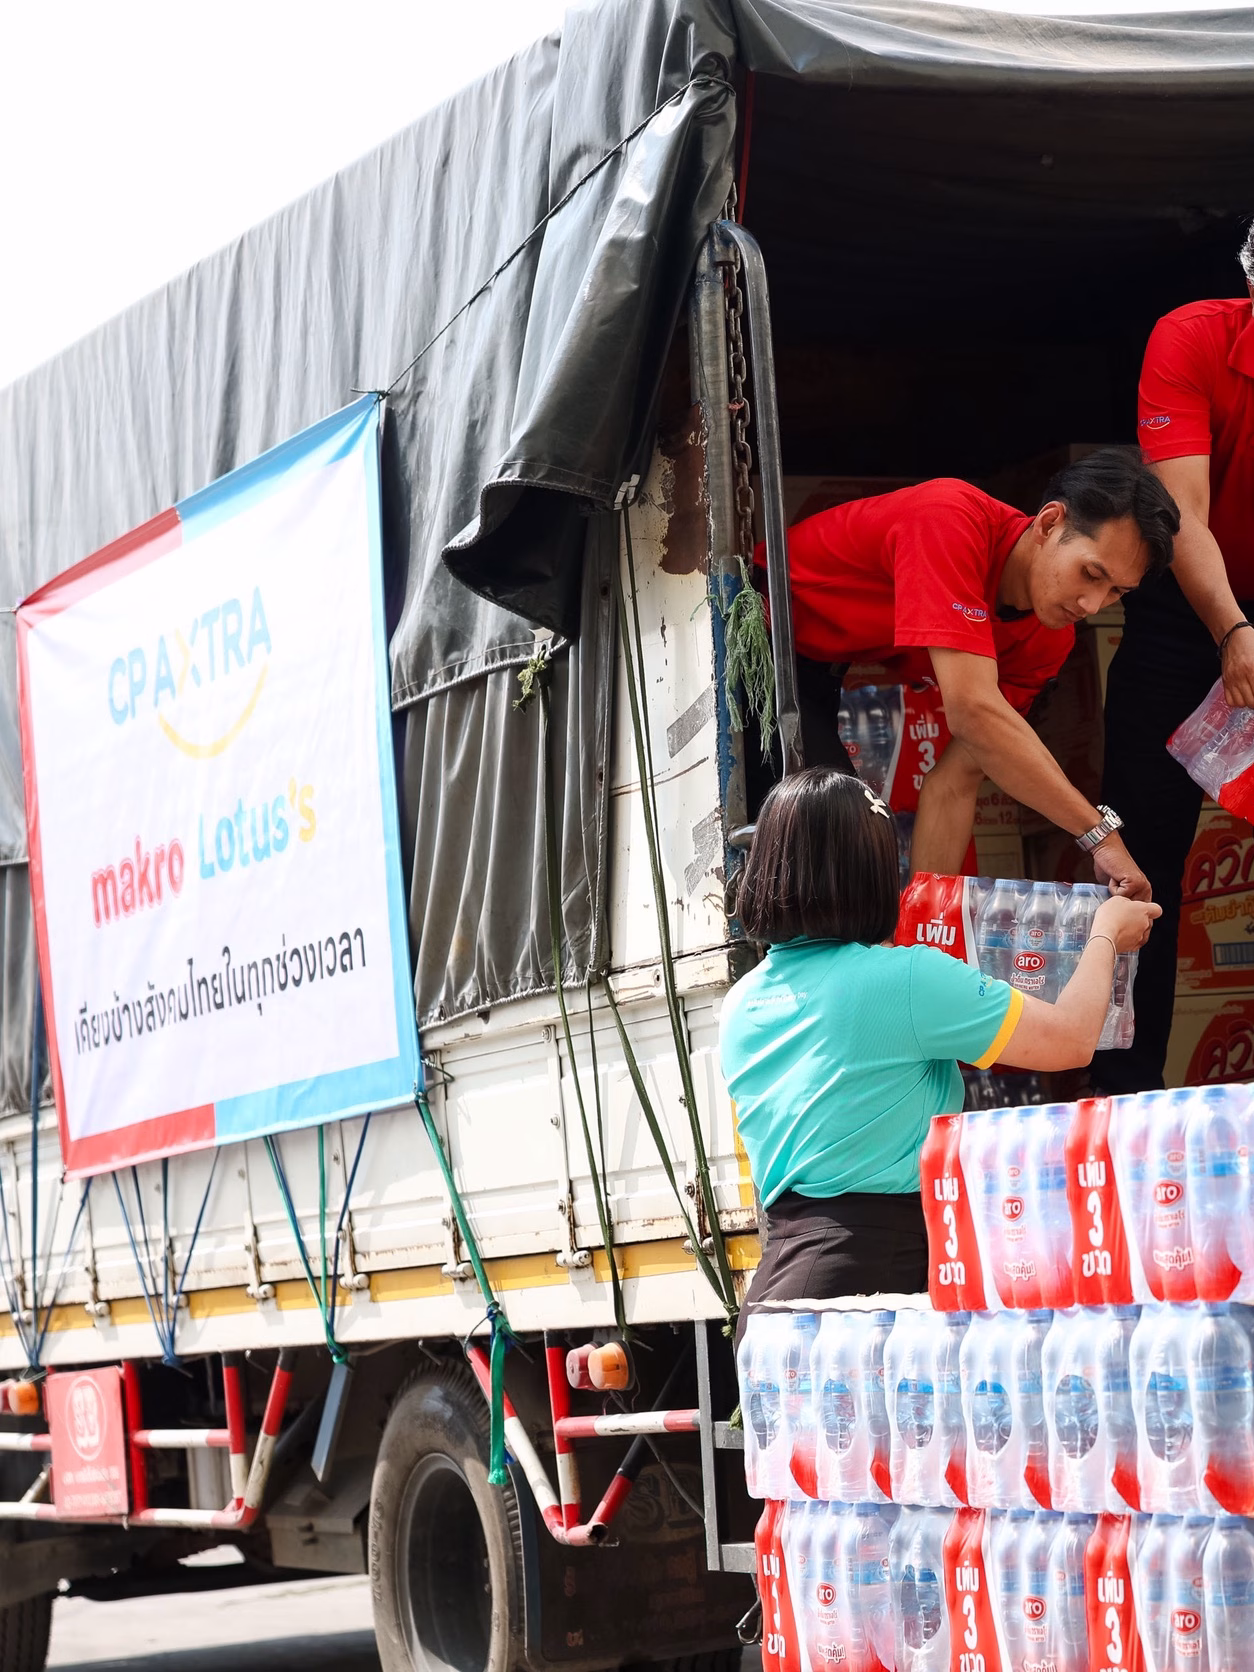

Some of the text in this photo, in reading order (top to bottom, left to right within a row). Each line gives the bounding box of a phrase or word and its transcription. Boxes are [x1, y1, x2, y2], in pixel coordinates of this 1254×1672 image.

[909, 714, 939, 740] เพิ่ม
[917, 741, 936, 774] 3
[91, 776, 317, 929] makro Lotus's
[916, 914, 956, 947] เพิ่ม
[1018, 956, 1040, 967] aro
[74, 927, 367, 1055] เคียงข้างสังคมไทยในทุกช่วงเวลา
[1087, 1190, 1104, 1247] 3
[963, 1595, 977, 1649] 3
[1105, 1607, 1123, 1665] 3
